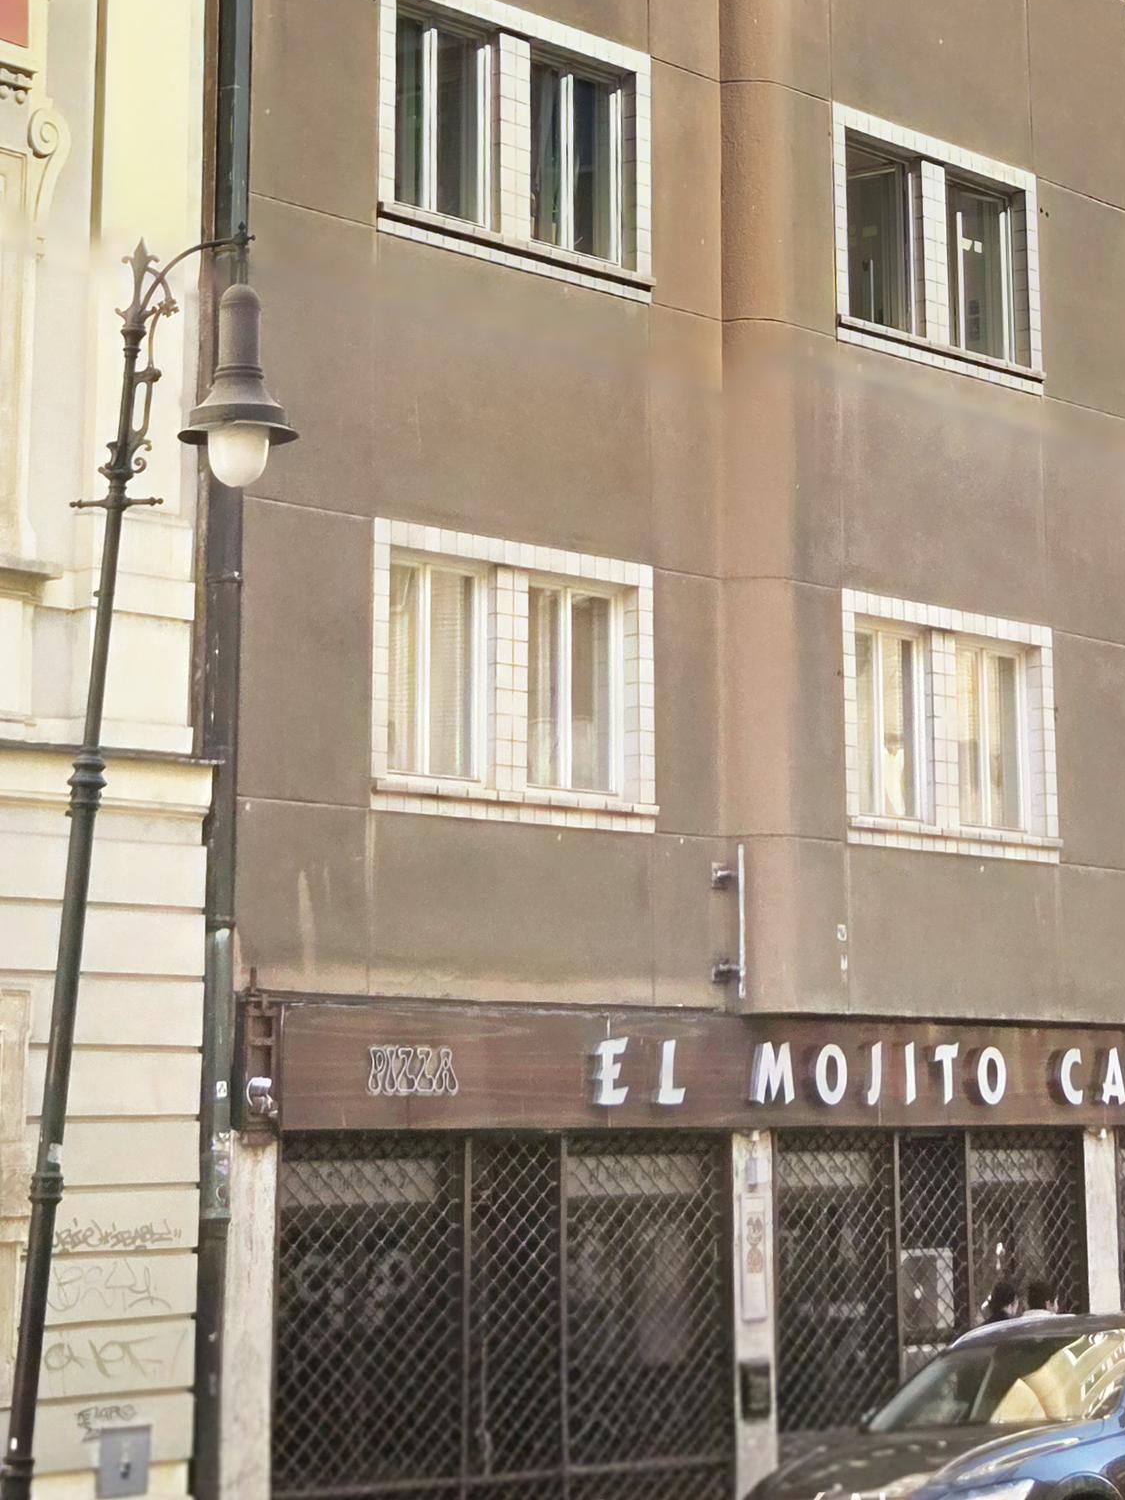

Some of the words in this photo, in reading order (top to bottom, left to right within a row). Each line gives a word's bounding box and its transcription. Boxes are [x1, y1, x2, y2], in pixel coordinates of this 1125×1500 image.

[367, 1045, 459, 1097] PIZZA
[596, 1036, 688, 1106] EL
[754, 1040, 1008, 1106] MOJITO
